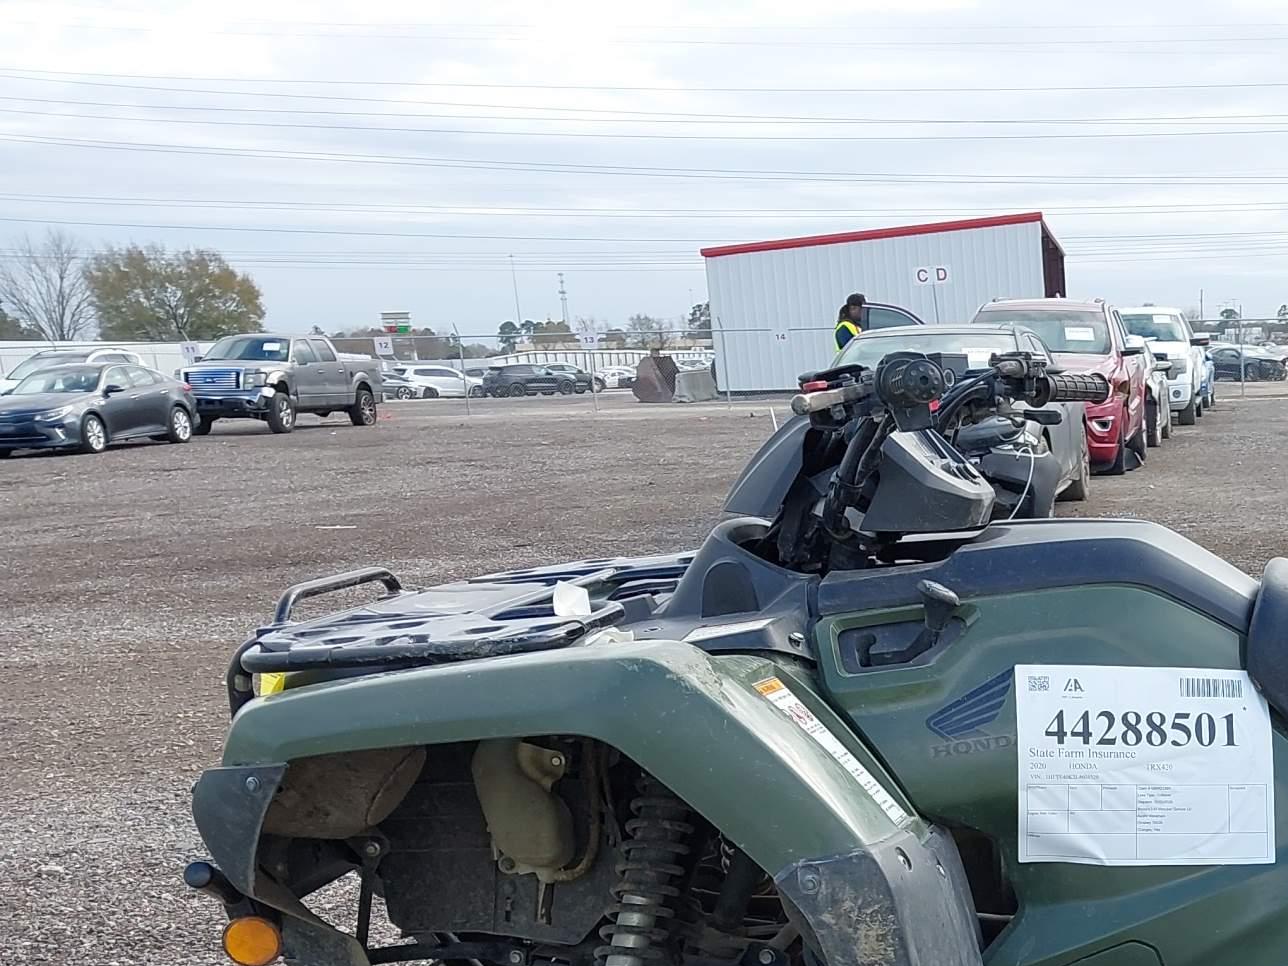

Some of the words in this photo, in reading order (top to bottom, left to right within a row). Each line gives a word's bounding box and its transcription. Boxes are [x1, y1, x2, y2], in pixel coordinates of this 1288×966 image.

[917, 269, 928, 282] C
[936, 268, 947, 281] D
[1044, 709, 1240, 747] 44288501
[1029, 747, 1055, 758] State
[1058, 748, 1084, 759] Farm
[1088, 748, 1137, 759] Insurance
[1030, 762, 1047, 770] 2020
